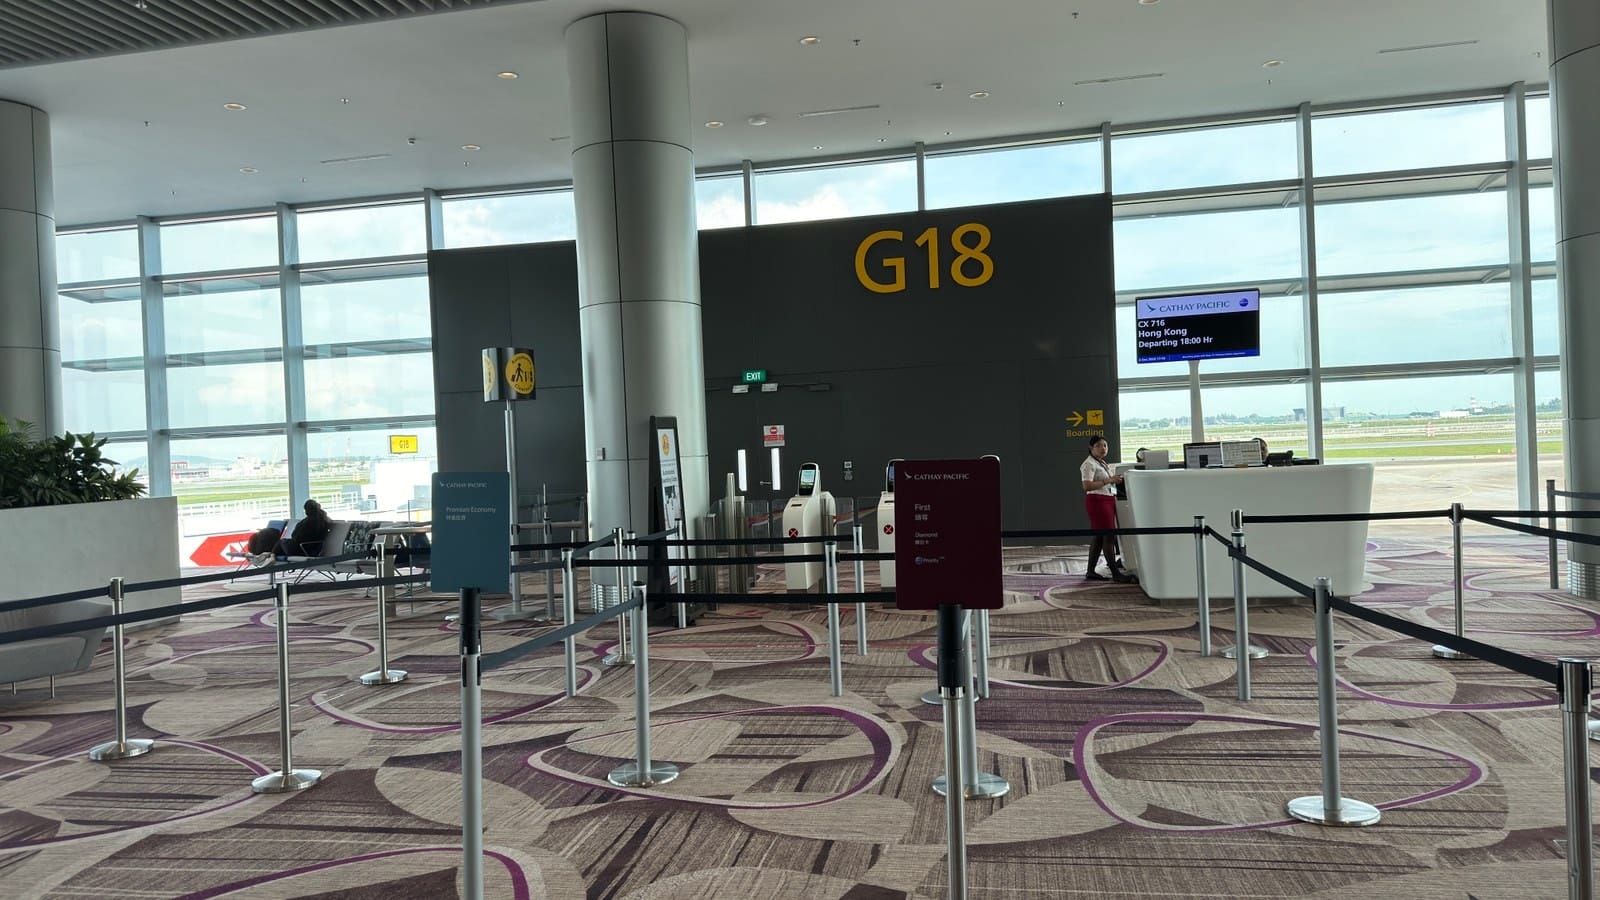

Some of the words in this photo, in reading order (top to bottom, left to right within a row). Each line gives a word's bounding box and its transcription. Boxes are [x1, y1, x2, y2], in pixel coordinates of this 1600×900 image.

[854, 222, 994, 294] G18
[1159, 303, 1195, 312] CATHAY
[1196, 301, 1230, 310] PACIFIC
[1150, 319, 1166, 327] 716
[1138, 329, 1162, 339] Hong
[1164, 327, 1188, 337] Kong
[1138, 339, 1178, 349] Departing
[1180, 336, 1202, 345] 18:00
[1203, 336, 1213, 344] Hr
[746, 371, 761, 381] EXIT
[1066, 428, 1104, 438] Boarding
[471, 506, 496, 514] Economy
